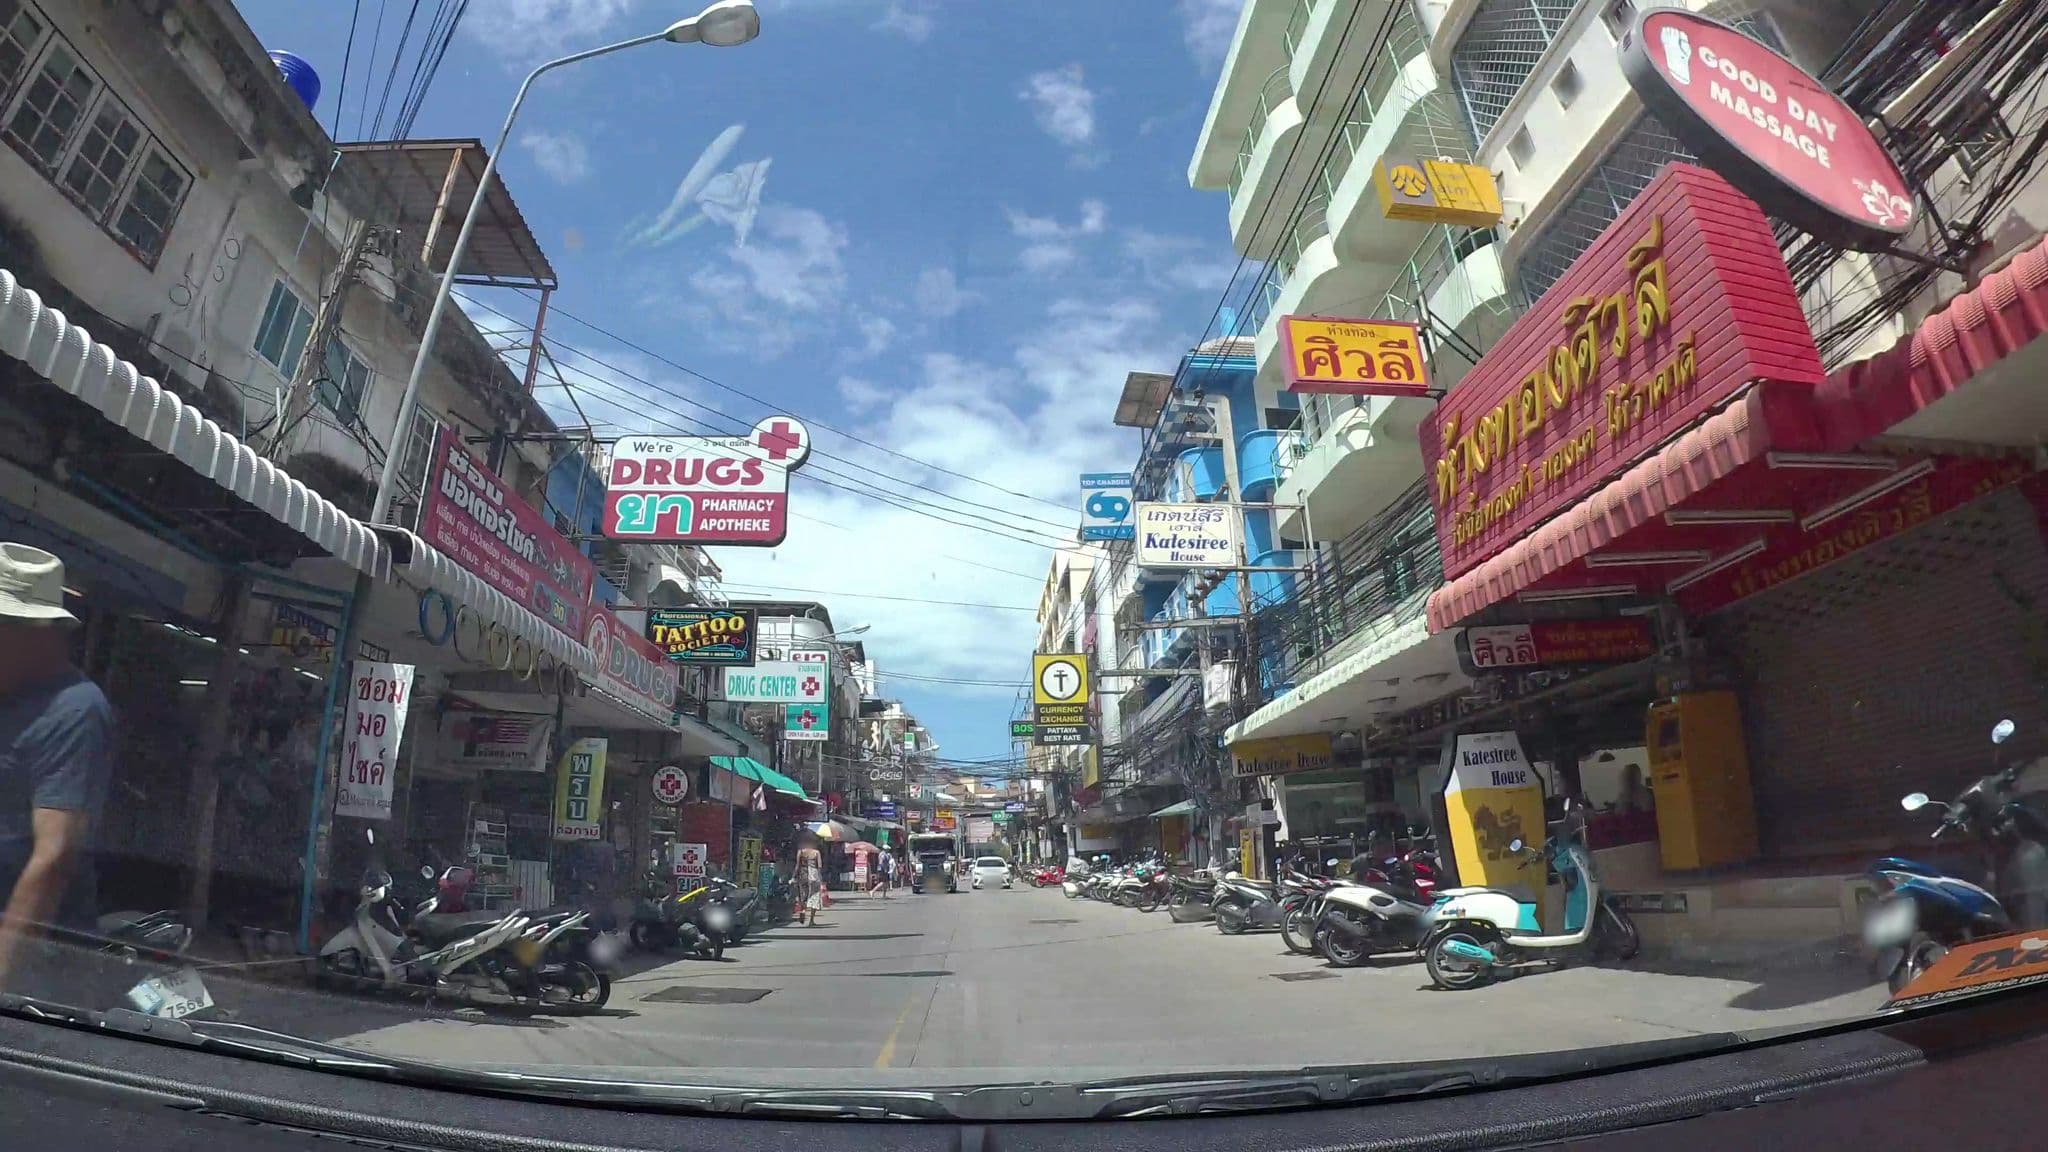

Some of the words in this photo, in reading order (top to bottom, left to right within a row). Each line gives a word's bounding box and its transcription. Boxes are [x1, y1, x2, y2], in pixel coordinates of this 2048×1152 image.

[1698, 46, 1777, 104] GOOD
[1787, 96, 1837, 142] DAY
[1710, 80, 1831, 169] MASSAGE
[1327, 324, 1376, 339] ห้างทอง
[1302, 336, 1415, 381] ศิวลี
[633, 441, 673, 453] We're
[611, 457, 765, 486] DRUGS
[615, 494, 693, 534] ยา
[702, 499, 775, 512] PHARMACY
[700, 518, 770, 531] APOTHEKE
[1144, 532, 1229, 550] Katesiree
[1170, 551, 1206, 562] House
[652, 615, 746, 644] TATTOO
[669, 634, 731, 653] SOCIETY
[1475, 632, 1537, 666] ศิวลี
[608, 634, 675, 708] DRUGS
[728, 675, 755, 697] DRUG
[759, 675, 797, 697] CENTER
[357, 711, 386, 737] มอ
[1463, 747, 1518, 767] Katesiree
[1491, 770, 1526, 786] House
[676, 864, 703, 874] DRUGS
